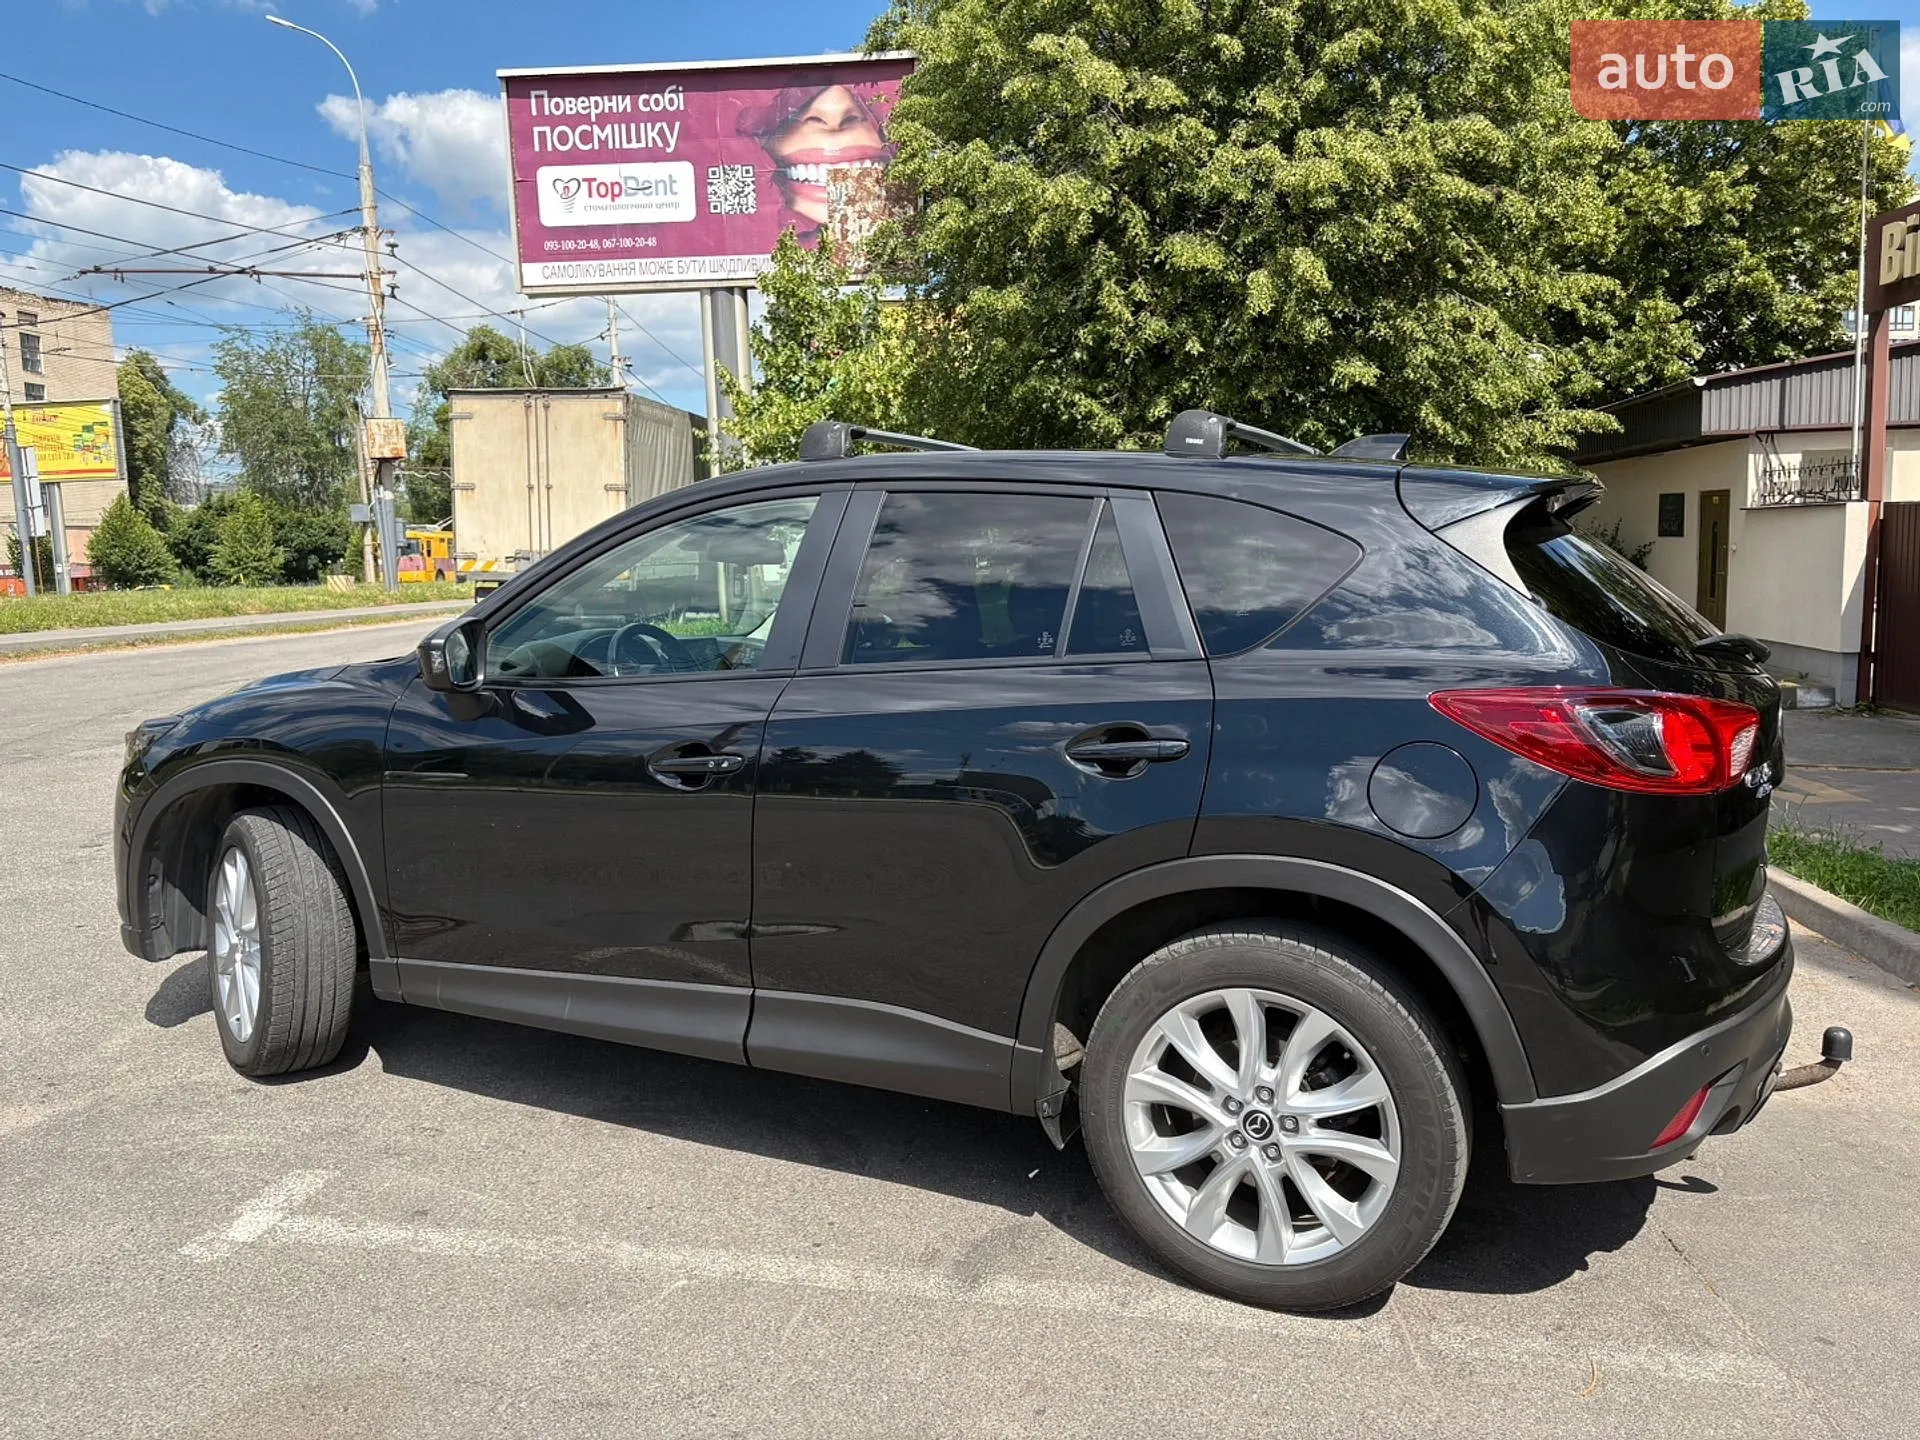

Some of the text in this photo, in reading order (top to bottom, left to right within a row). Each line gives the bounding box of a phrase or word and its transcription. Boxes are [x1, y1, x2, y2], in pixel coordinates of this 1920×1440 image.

[530, 85, 685, 122] Поверни собі
[582, 173, 678, 202] TopDent
[1879, 213, 1920, 286] Ві
[541, 262, 636, 280] САМОЛІКУВАННЯ
[638, 260, 674, 277] МОЖЕ
[677, 259, 707, 275] БУТИ
